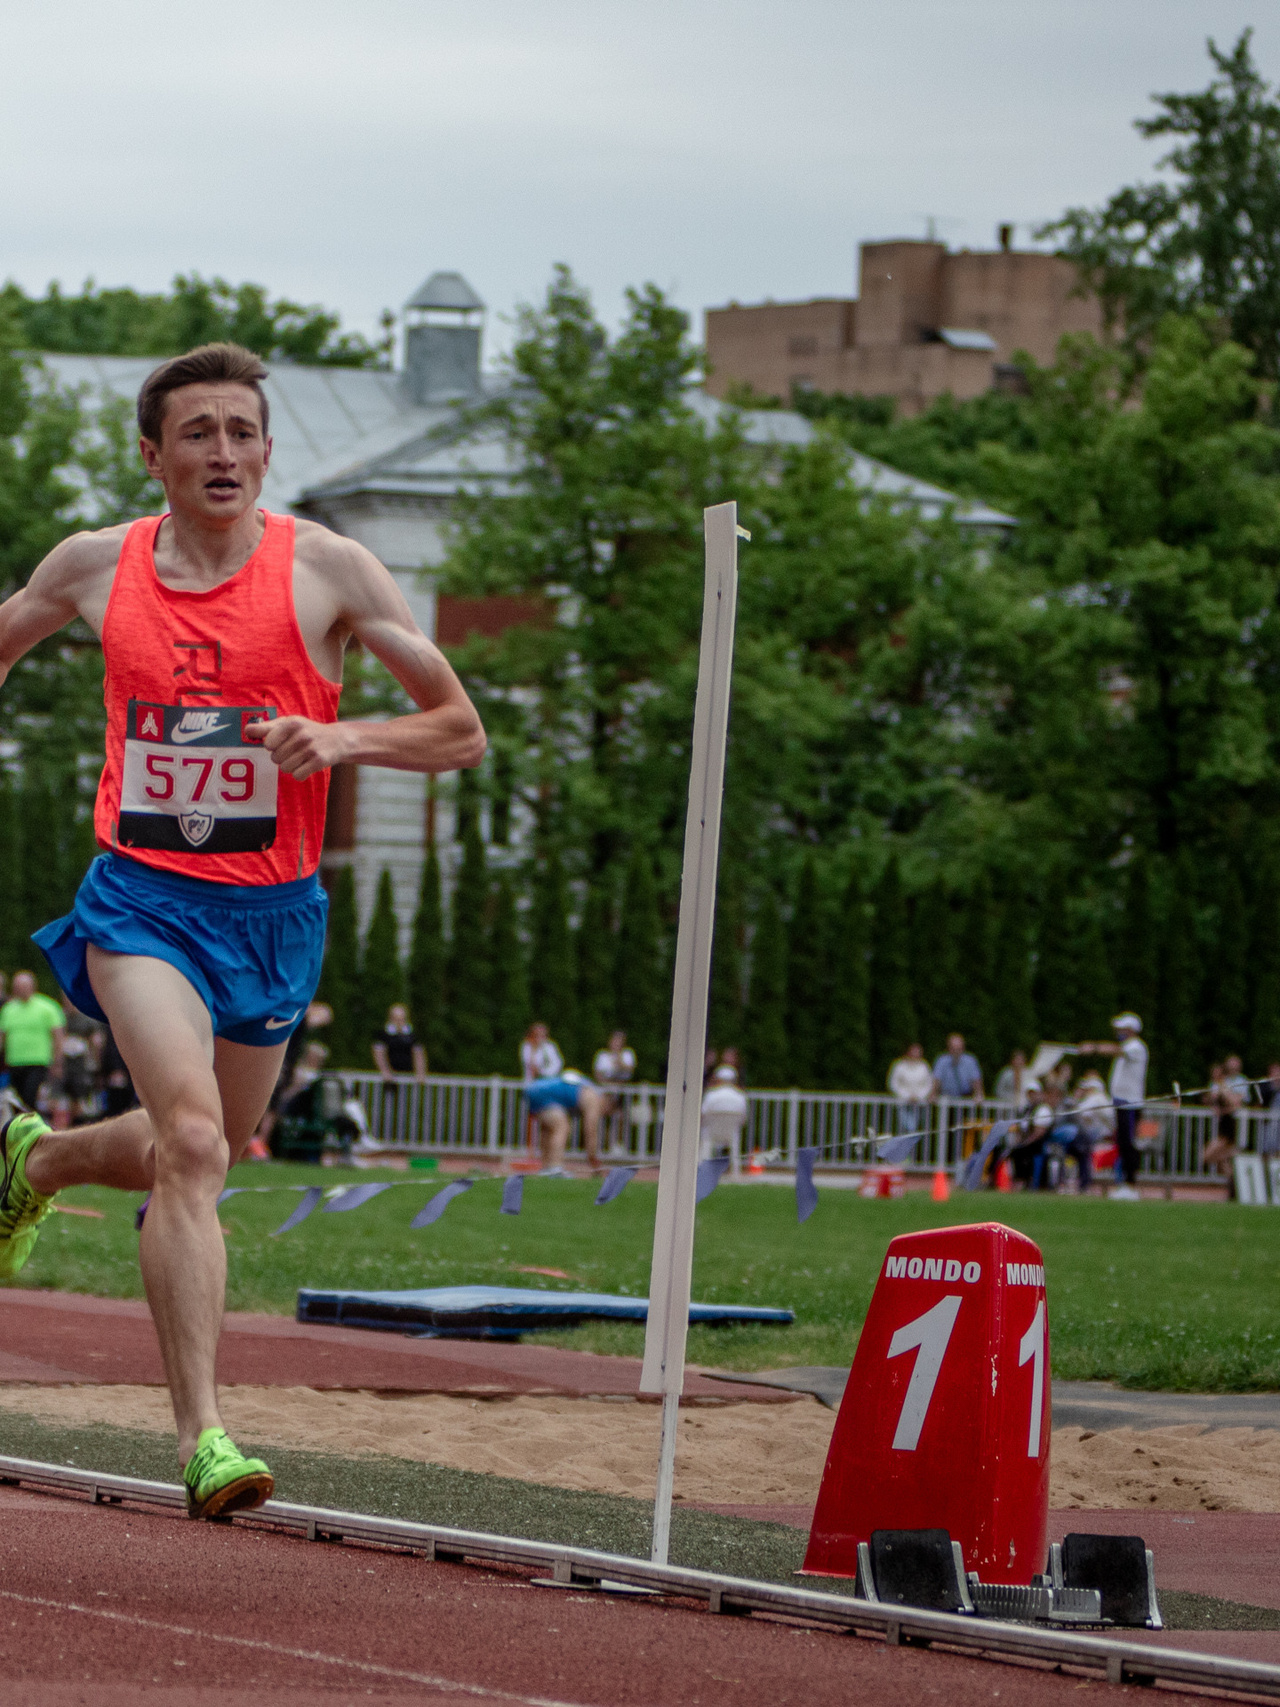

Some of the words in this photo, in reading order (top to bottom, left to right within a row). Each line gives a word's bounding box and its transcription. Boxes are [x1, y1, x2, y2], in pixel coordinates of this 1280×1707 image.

[179, 711, 220, 730] NIKE
[144, 754, 256, 803] 579
[885, 1256, 981, 1283] MONDO
[886, 1295, 963, 1451] 1
[1018, 1300, 1045, 1458] 1
